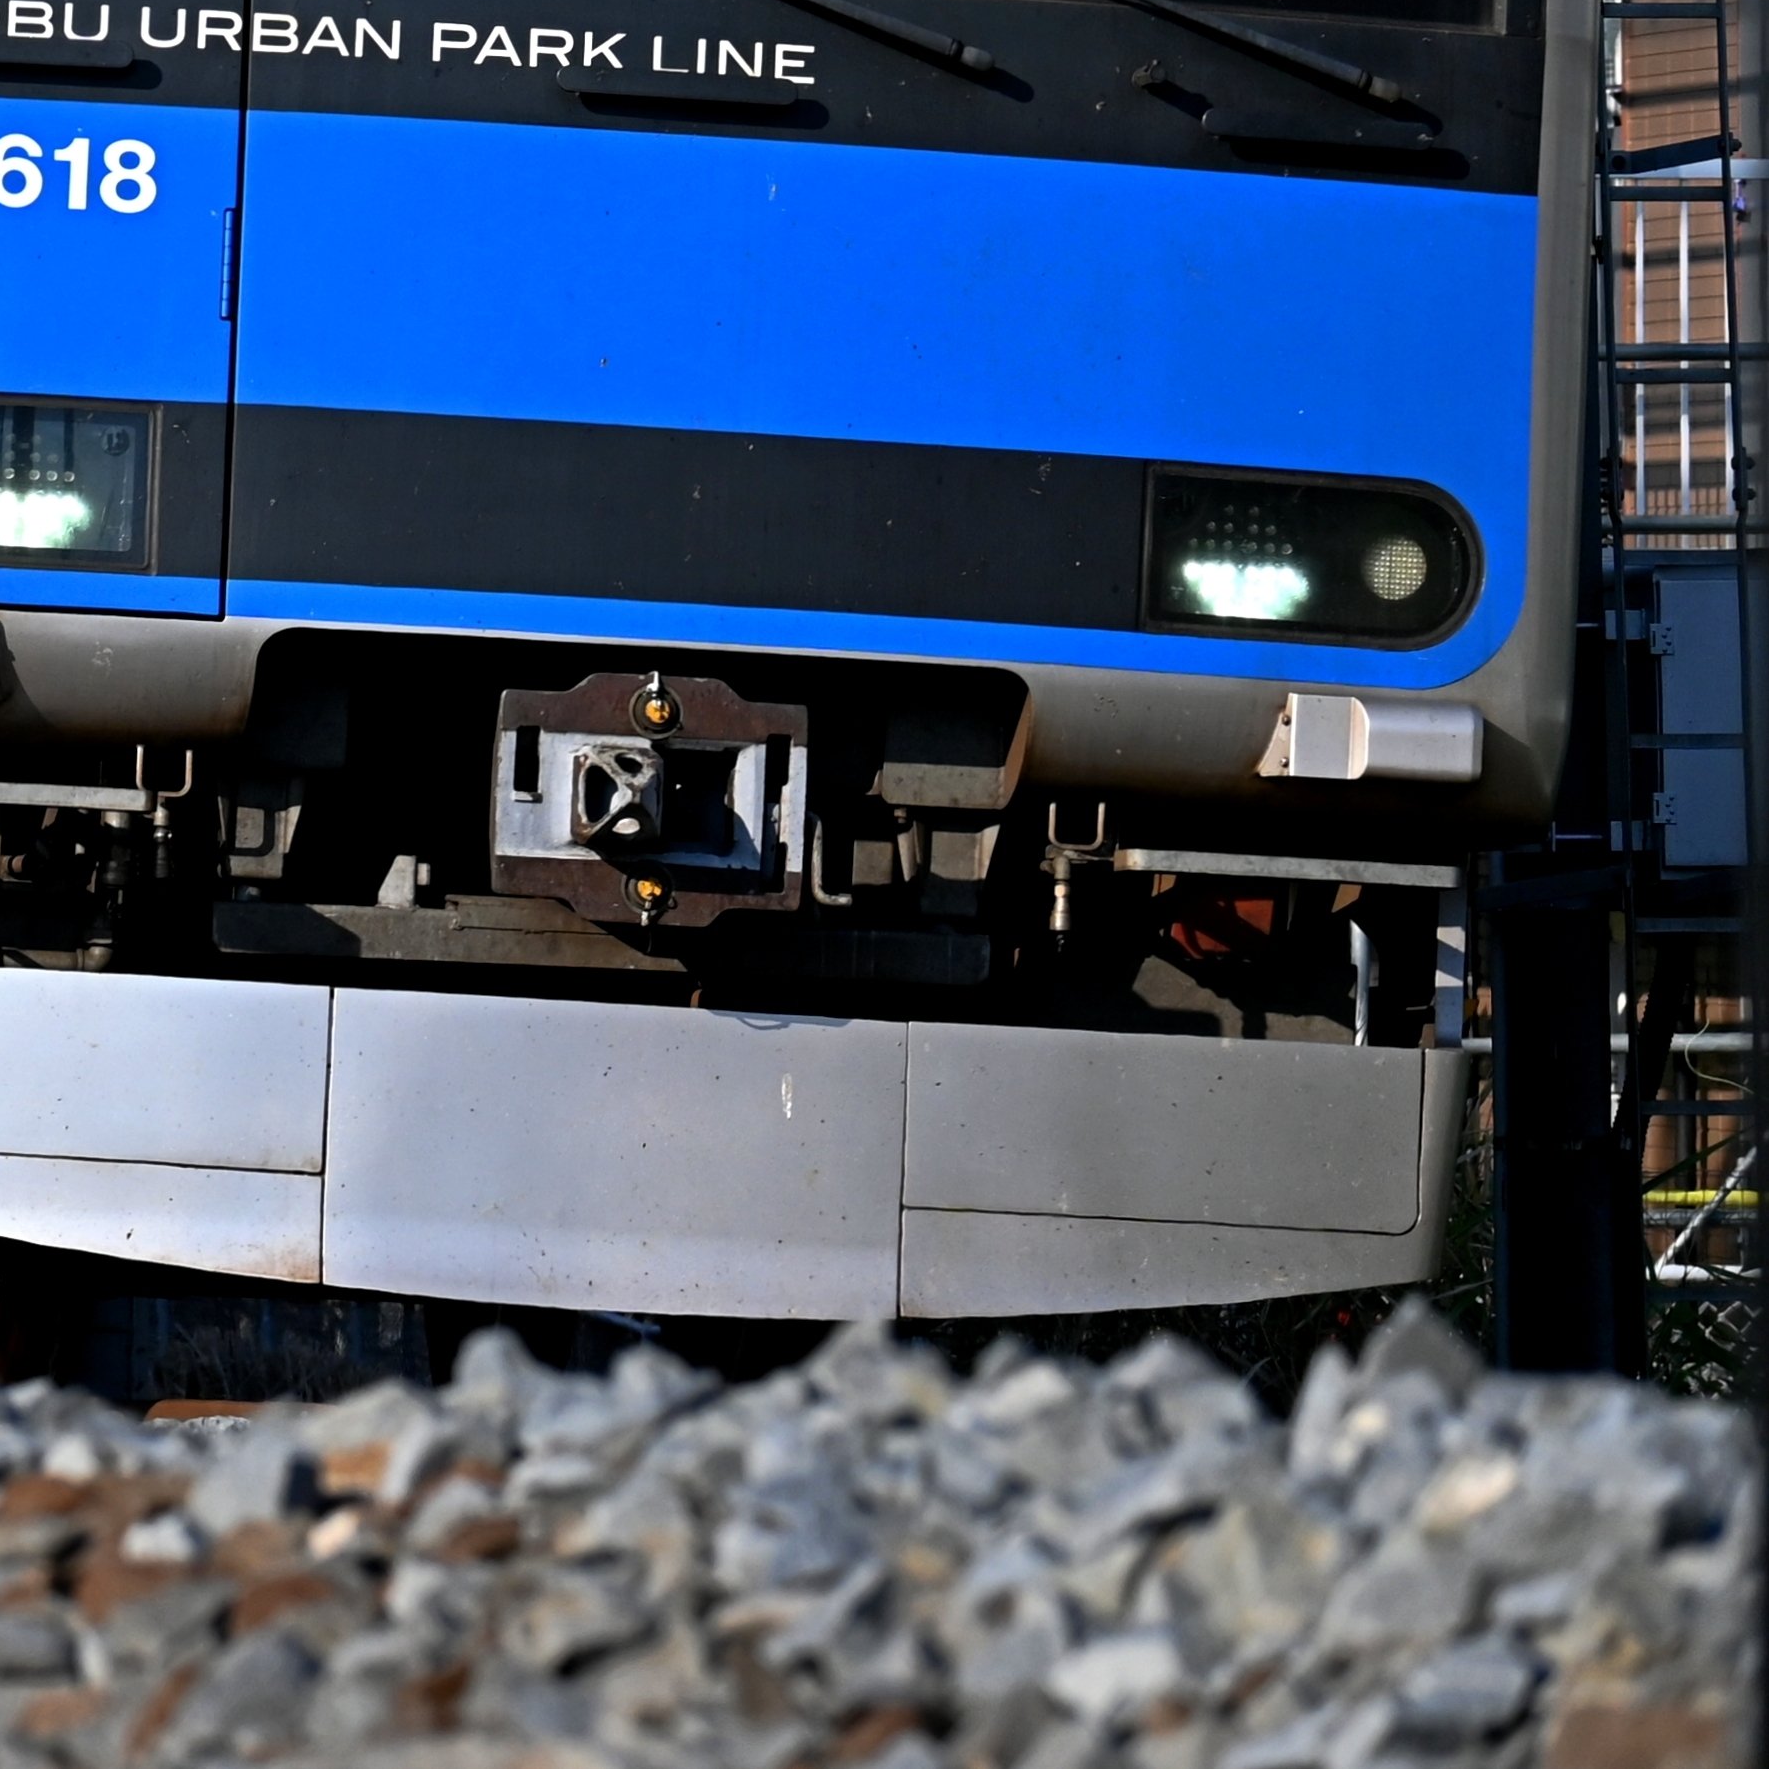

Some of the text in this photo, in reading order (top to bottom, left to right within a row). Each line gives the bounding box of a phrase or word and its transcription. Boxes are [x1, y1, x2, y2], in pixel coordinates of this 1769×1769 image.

[140, 6, 401, 62] URBAN
[431, 22, 627, 68] PARK
[652, 35, 816, 85] LINE
